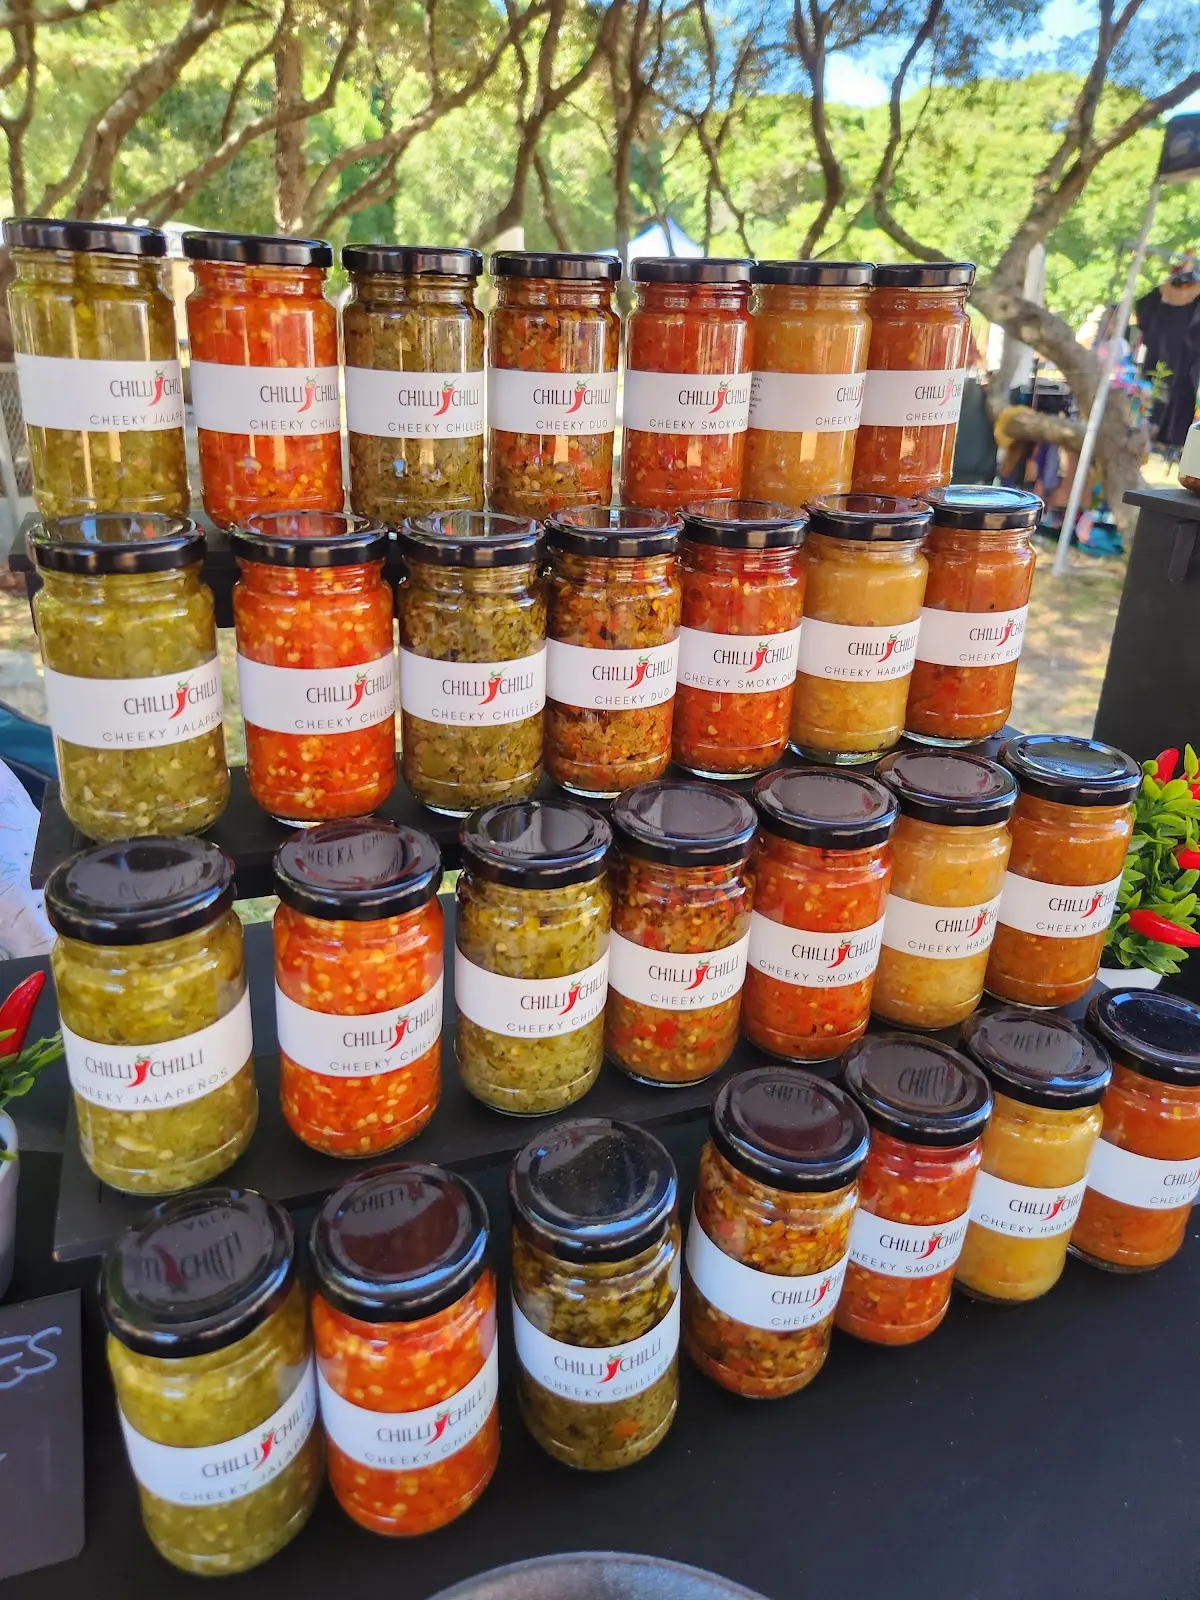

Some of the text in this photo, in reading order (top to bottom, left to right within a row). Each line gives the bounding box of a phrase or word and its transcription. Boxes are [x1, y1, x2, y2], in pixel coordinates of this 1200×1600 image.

[109, 380, 153, 398] CHILLI
[260, 385, 303, 403] CHILLI
[398, 388, 479, 407] CHILLI CHILLI
[533, 388, 611, 405] CHILLI CHILLI
[678, 389, 716, 406] CHILLI
[725, 387, 748, 405] CHILLI
[914, 385, 945, 400] CHILLI
[89, 411, 182, 426] CHEEKY JALAPE
[249, 419, 304, 431] CHEEKY
[536, 419, 608, 431] CHEEKY DUO
[649, 418, 695, 430] CHEEKY
[701, 419, 736, 430] SMOKY
[815, 415, 851, 426] CHEEKY
[905, 412, 944, 422] CHEEKY
[388, 422, 440, 433] CHEEKY
[969, 627, 1004, 641] CHILLI
[847, 634, 917, 656] CHILLI CHILLI
[713, 644, 793, 666] CHILLI CHILLI
[958, 652, 1003, 662] CHEEKY
[592, 656, 673, 681] CHILLI CHILLI
[824, 660, 914, 677] CHEEKY HABANER
[306, 669, 393, 704] CHILLI CHILLI
[442, 672, 534, 697] CHILLI CHILLI
[684, 671, 731, 688] CHEEKY
[737, 676, 778, 689] SMOKY
[123, 677, 218, 715] CHILLI CHILLI
[594, 687, 670, 705] CHEEKY DUO
[431, 699, 539, 721] CHEEKY CHILLIES
[294, 716, 353, 729] CHEEKY
[102, 728, 167, 743] CHEEKY
[1048, 896, 1090, 912] CHILLI
[935, 917, 976, 933] CHILLI
[1035, 921, 1087, 933] CHEEKY
[791, 934, 878, 961] CHILLI CHILLI
[907, 940, 962, 953] CHEEKY
[648, 953, 740, 983] CHILLI CHILLI
[758, 958, 810, 982] CHEEKY
[816, 968, 861, 983] SMOKY
[520, 968, 607, 1010] CHILLI CHILLI
[649, 984, 734, 1006] CHEEKY DUO
[343, 998, 438, 1048] CHILLI CHILLI
[506, 1020, 565, 1034] CHEEKY
[85, 1048, 204, 1080] CHILLI CHILLI
[329, 1056, 393, 1072] CHEEKY
[74, 1076, 124, 1104] CHEEKY
[1163, 1169, 1198, 1186] CHILLI
[1008, 1199, 1052, 1215] CHILLI
[980, 1213, 1034, 1233] CHEEKY
[879, 1234, 925, 1253] CHILLI
[851, 1248, 897, 1271] HEEKY
[904, 1256, 949, 1274] SMOKY
[771, 1287, 818, 1305] CHILLI
[770, 1308, 824, 1326] CHEEKY
[553, 1337, 661, 1377] CHILLI CHILLI
[543, 1354, 670, 1398] CHEEKY CHILLIES
[376, 1381, 487, 1443] CHILLI CHILLI
[202, 1390, 308, 1478] CHILLI CHILLI
[364, 1450, 432, 1466] CHEEKY
[180, 1481, 249, 1501] CHEEKY
